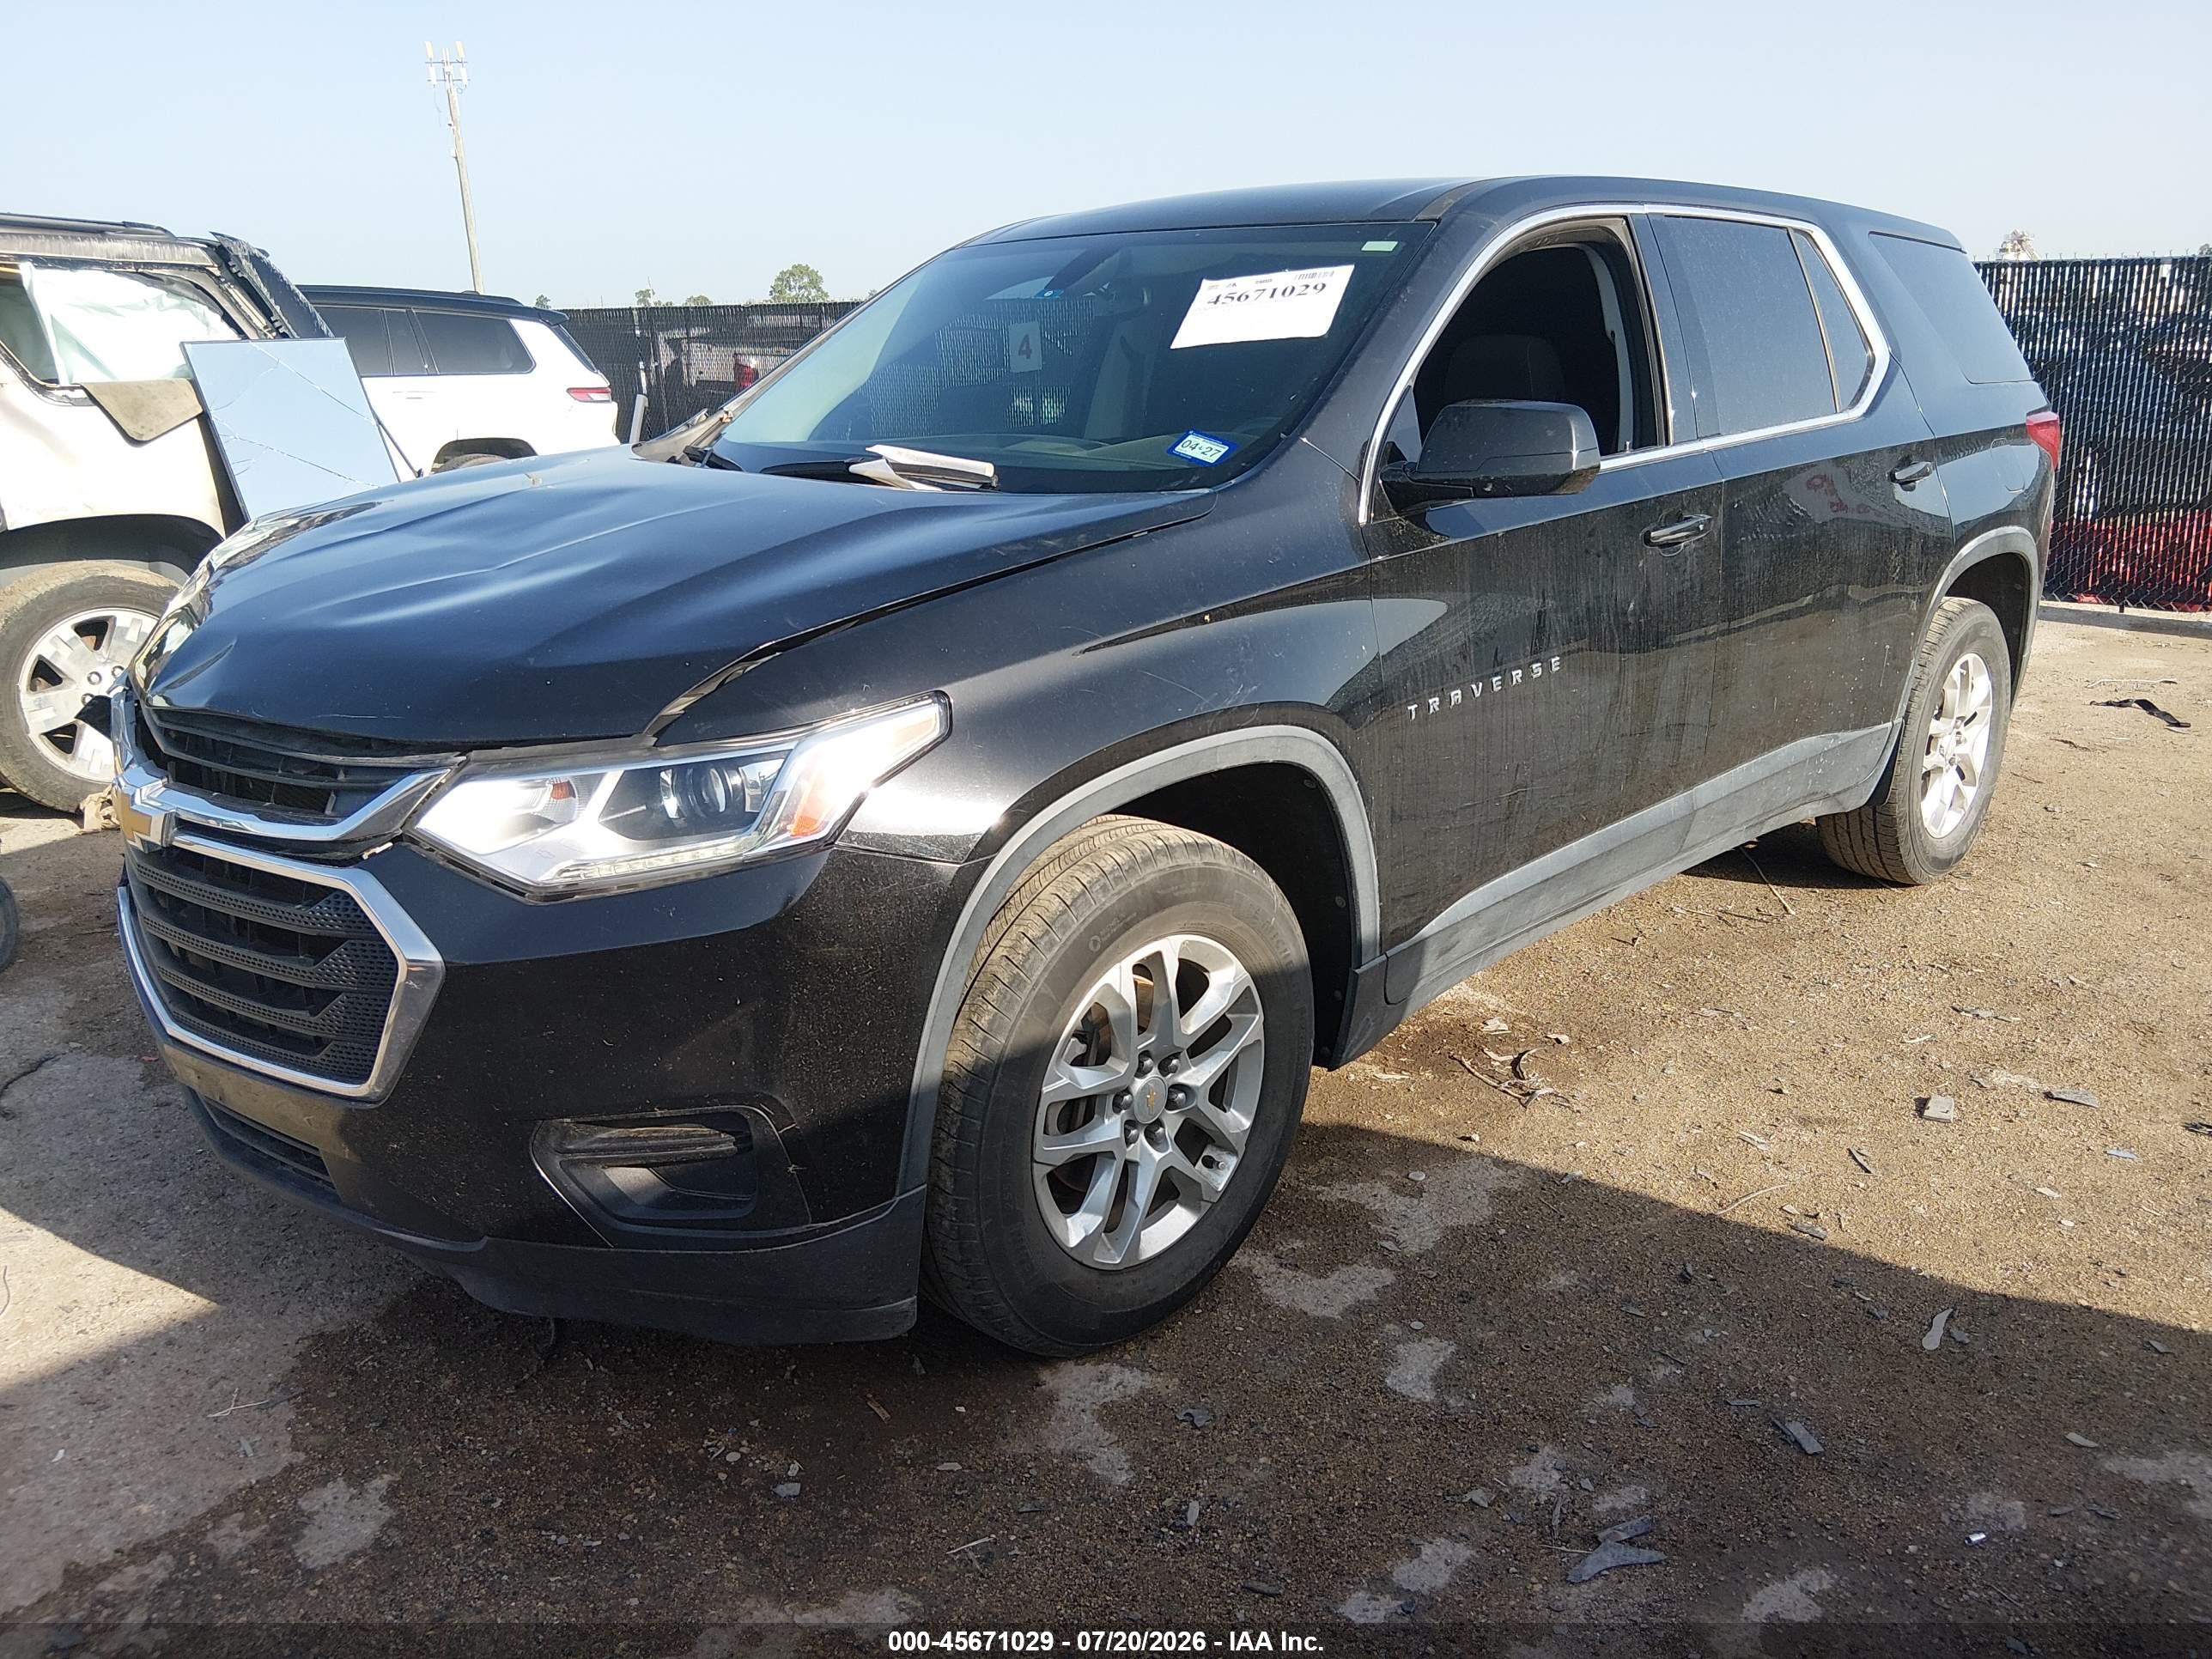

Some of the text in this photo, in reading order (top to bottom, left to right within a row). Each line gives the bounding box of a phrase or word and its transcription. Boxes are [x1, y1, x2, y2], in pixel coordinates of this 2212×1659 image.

[1206, 282, 1328, 306] 45671029
[1018, 333, 1033, 360] 4
[1407, 656, 1560, 721] TRAVERSE
